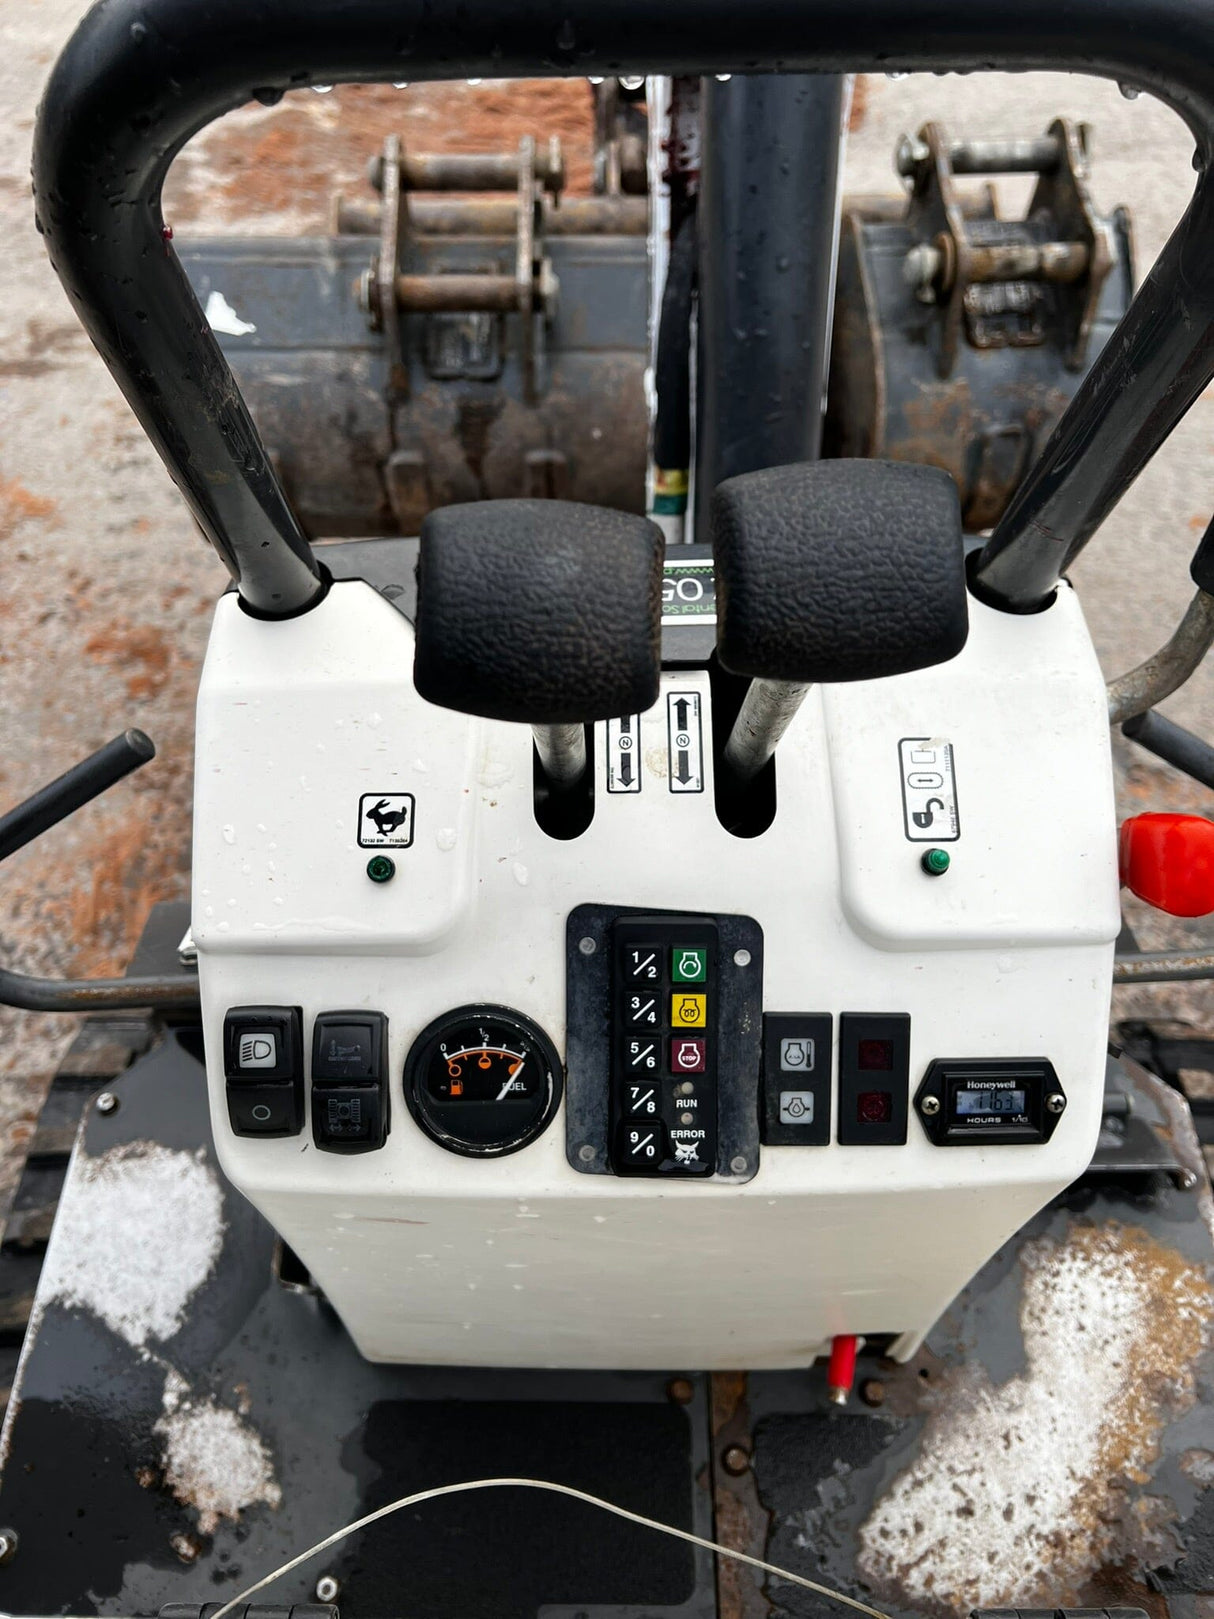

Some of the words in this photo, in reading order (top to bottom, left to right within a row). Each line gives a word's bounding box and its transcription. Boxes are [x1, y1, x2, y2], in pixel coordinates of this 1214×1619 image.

[632, 951, 657, 978] 1/2
[630, 997, 656, 1023] 3/4
[440, 1043, 447, 1051] 0
[630, 1042, 655, 1068] 5/6
[967, 1080, 1016, 1090] Honeywell
[630, 1088, 655, 1113] 7/8
[676, 1099, 698, 1108] RUN
[630, 1132, 655, 1157] 9/0
[670, 1129, 705, 1138] ERROR
